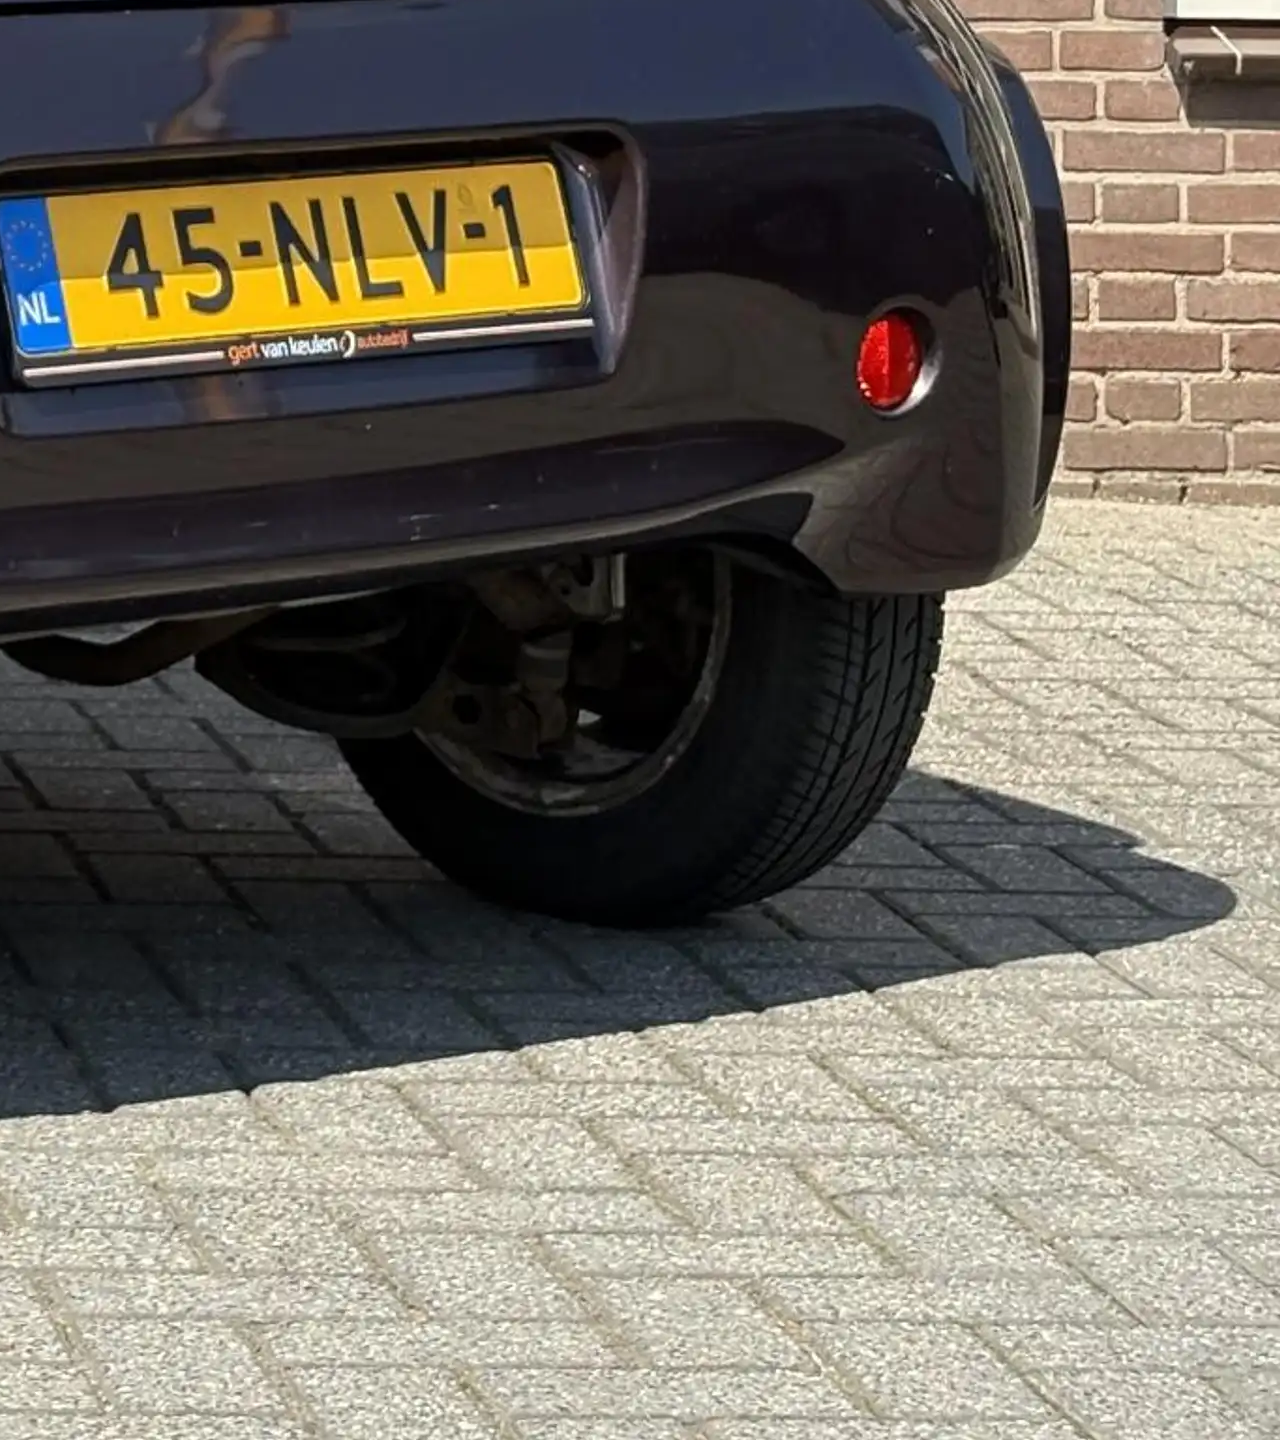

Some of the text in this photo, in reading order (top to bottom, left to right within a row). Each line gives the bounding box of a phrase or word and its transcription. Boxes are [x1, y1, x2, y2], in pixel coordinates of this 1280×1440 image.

[104, 183, 531, 320] 45-NLV-1
[16, 290, 62, 327] NL
[227, 341, 258, 366] gert
[260, 340, 289, 359] van
[288, 333, 339, 356] keulen
